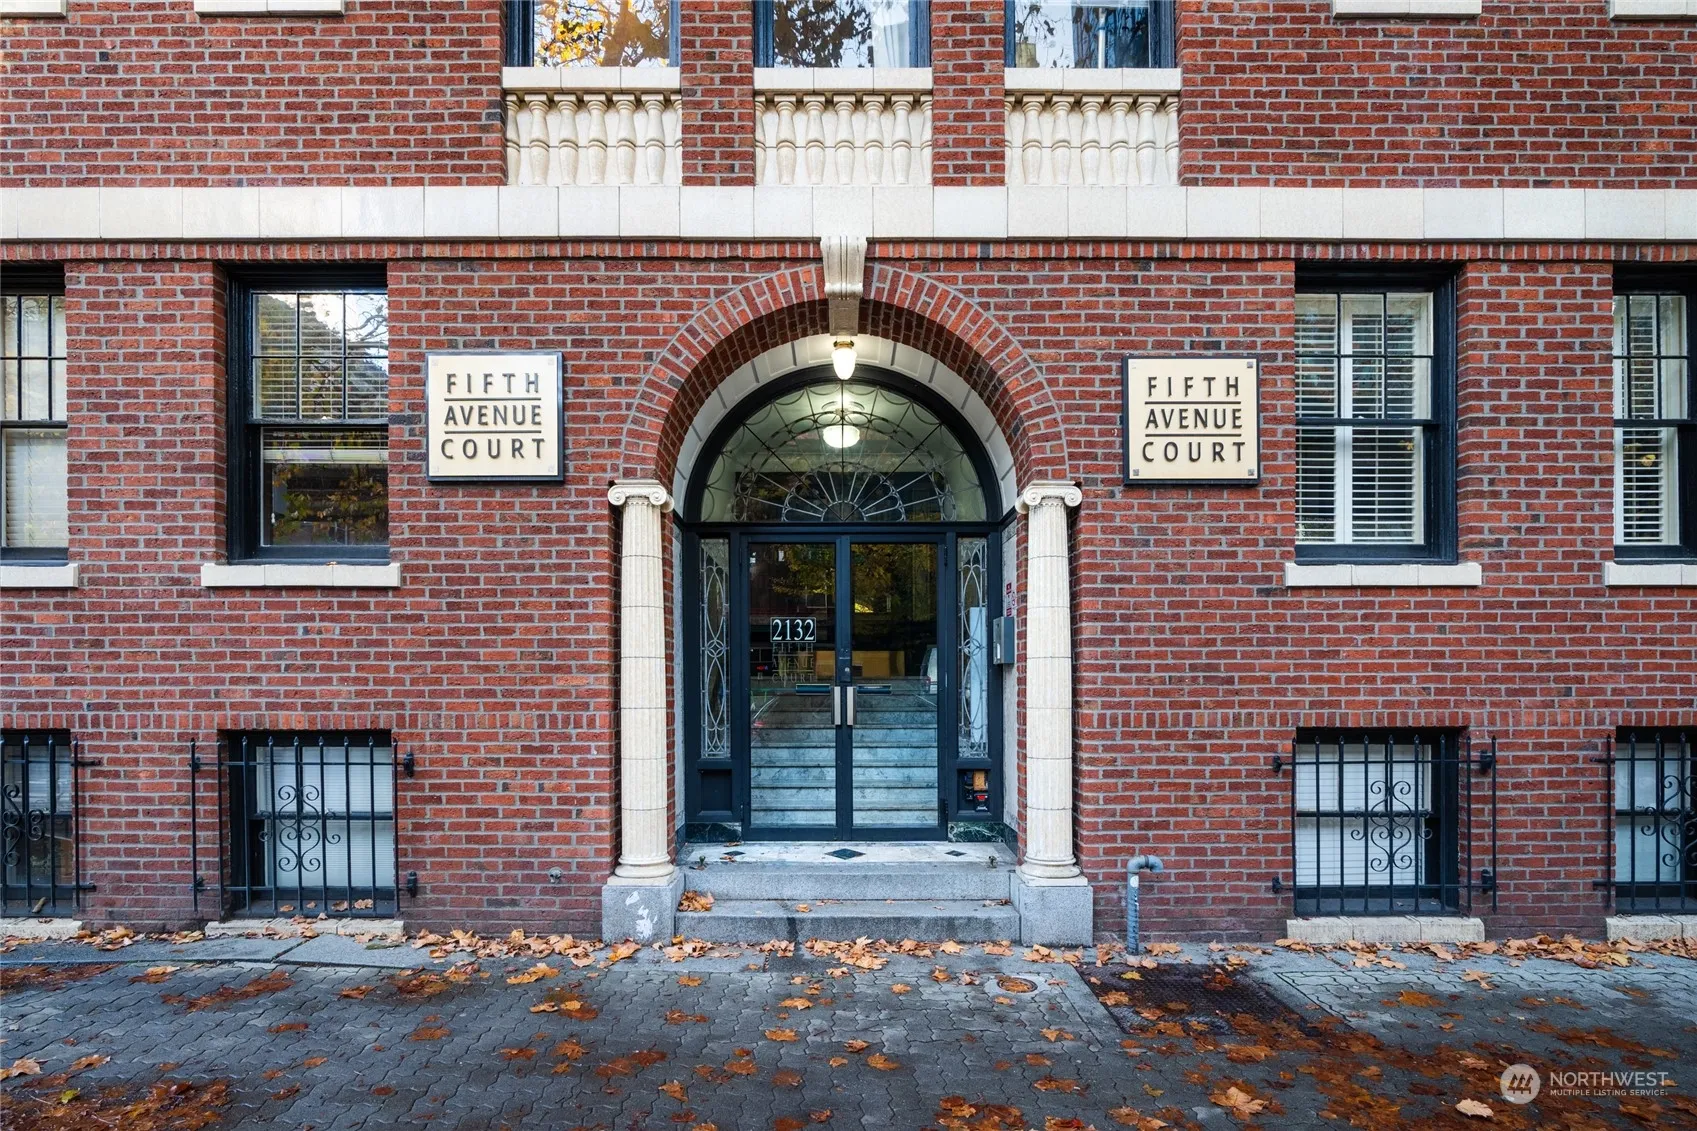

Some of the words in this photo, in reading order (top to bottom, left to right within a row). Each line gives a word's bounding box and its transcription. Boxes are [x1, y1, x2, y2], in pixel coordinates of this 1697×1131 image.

[446, 373, 539, 394] FIFTH
[1147, 376, 1239, 397] FIFTH
[444, 405, 542, 426] AVENUE
[1145, 408, 1243, 430] AVENUE
[441, 438, 545, 460] COURT
[1142, 441, 1246, 463] COURT
[772, 619, 815, 641] 2132
[772, 642, 814, 653] FIFTH
[772, 672, 814, 683] COURT
